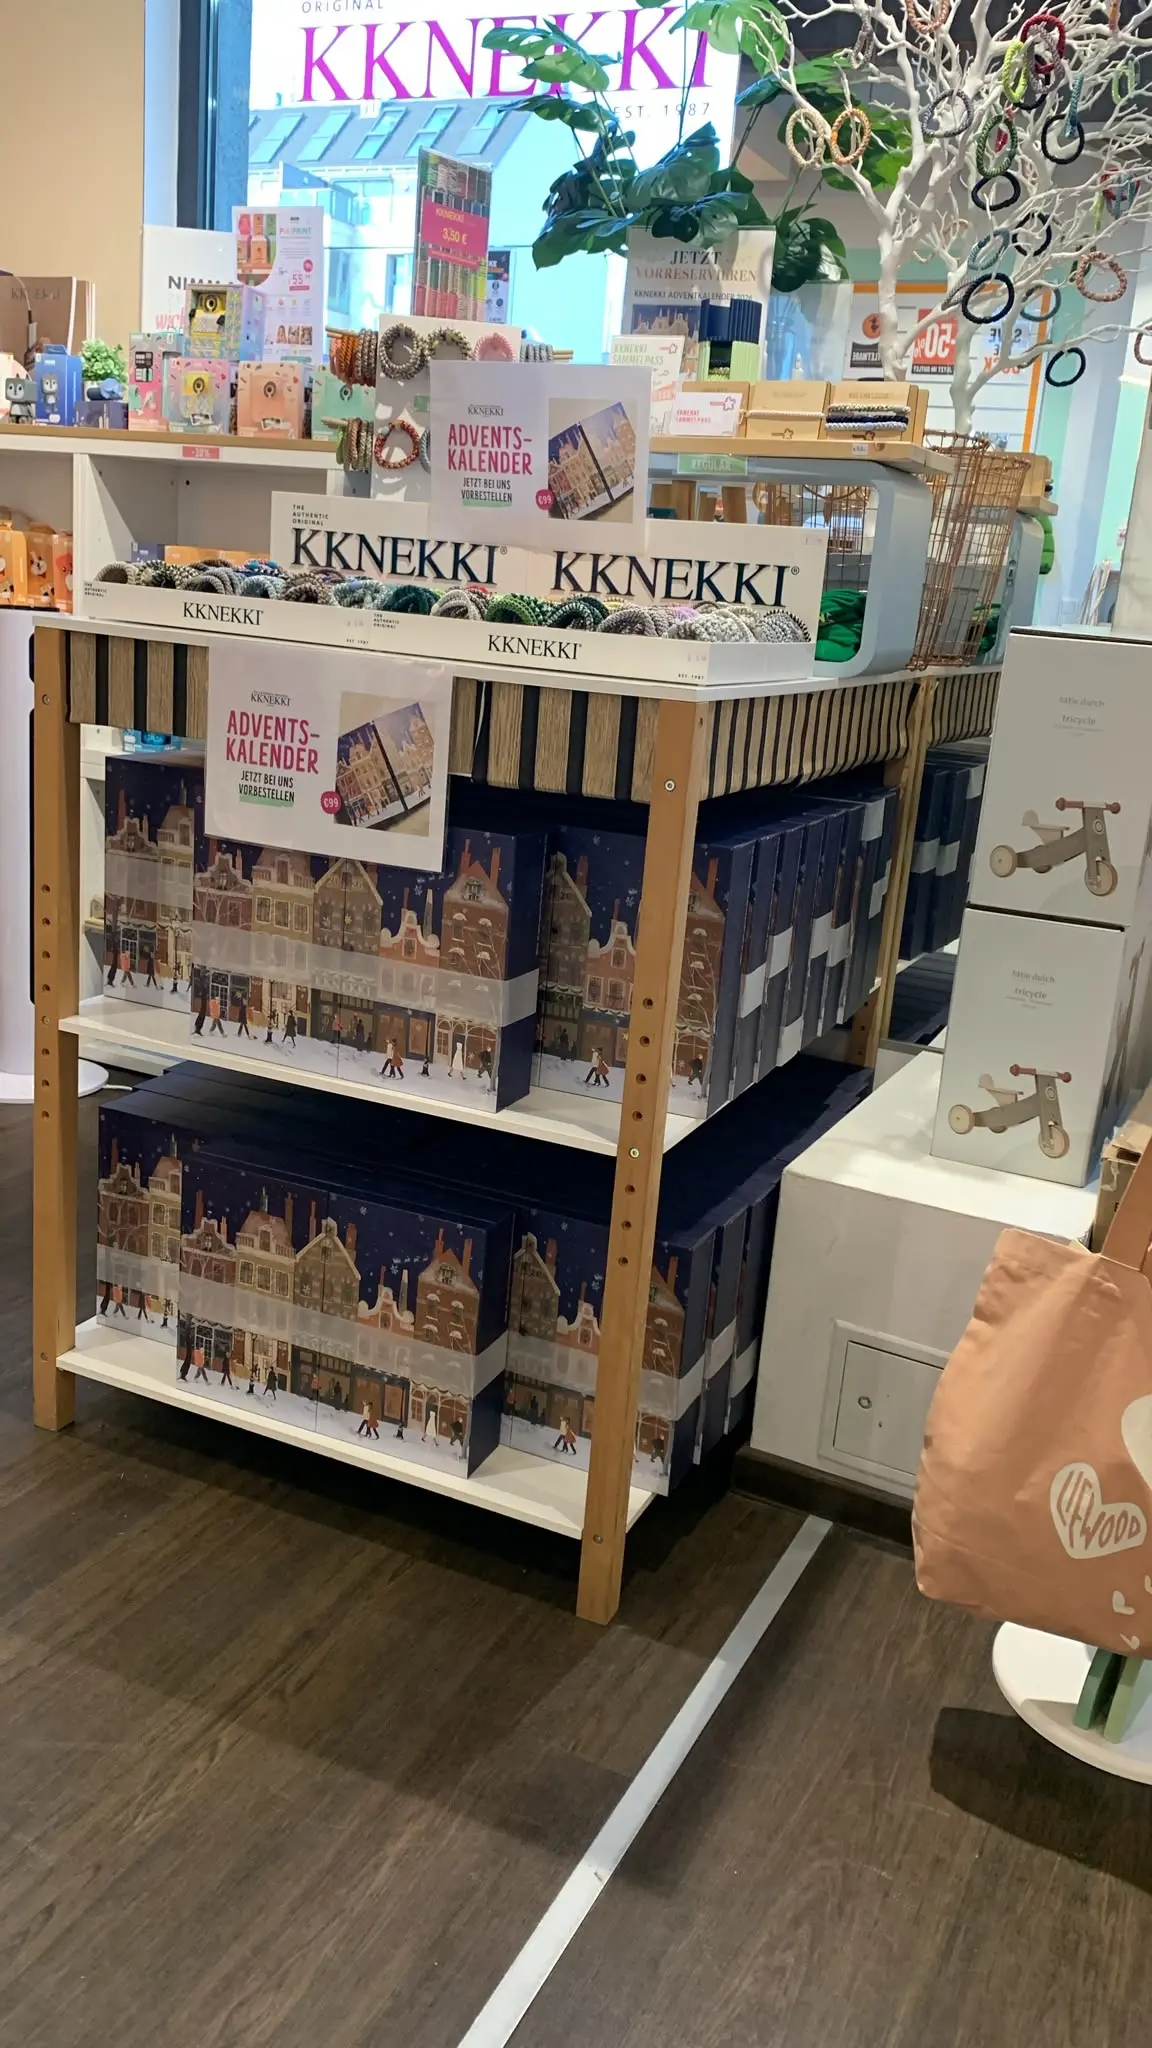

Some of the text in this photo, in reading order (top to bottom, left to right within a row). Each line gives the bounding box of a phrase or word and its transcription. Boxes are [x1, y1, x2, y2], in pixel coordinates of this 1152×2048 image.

[302, 0, 383, 13] ORIGINAL
[664, 102, 710, 116] 1987
[442, 227, 468, 245] 3,50 €
[670, 250, 722, 265] JETZT
[467, 406, 504, 417] KKNEKKI
[448, 423, 533, 450] ADVENTS-
[448, 449, 533, 475] KALENDER
[462, 478, 511, 490] JETZT BEI UNS
[461, 490, 512, 503] VORBESTELLEN
[292, 511, 329, 520] AUTHENTIC
[292, 518, 324, 526] ORIGINAL
[250, 692, 290, 706] KKNEKKI
[227, 710, 320, 746] ADVENTS-
[226, 738, 319, 775] KALENDER
[241, 771, 294, 789] JETZT BEI UNS
[238, 783, 295, 802] VORBESTELLEN
[323, 797, 339, 808] €99
